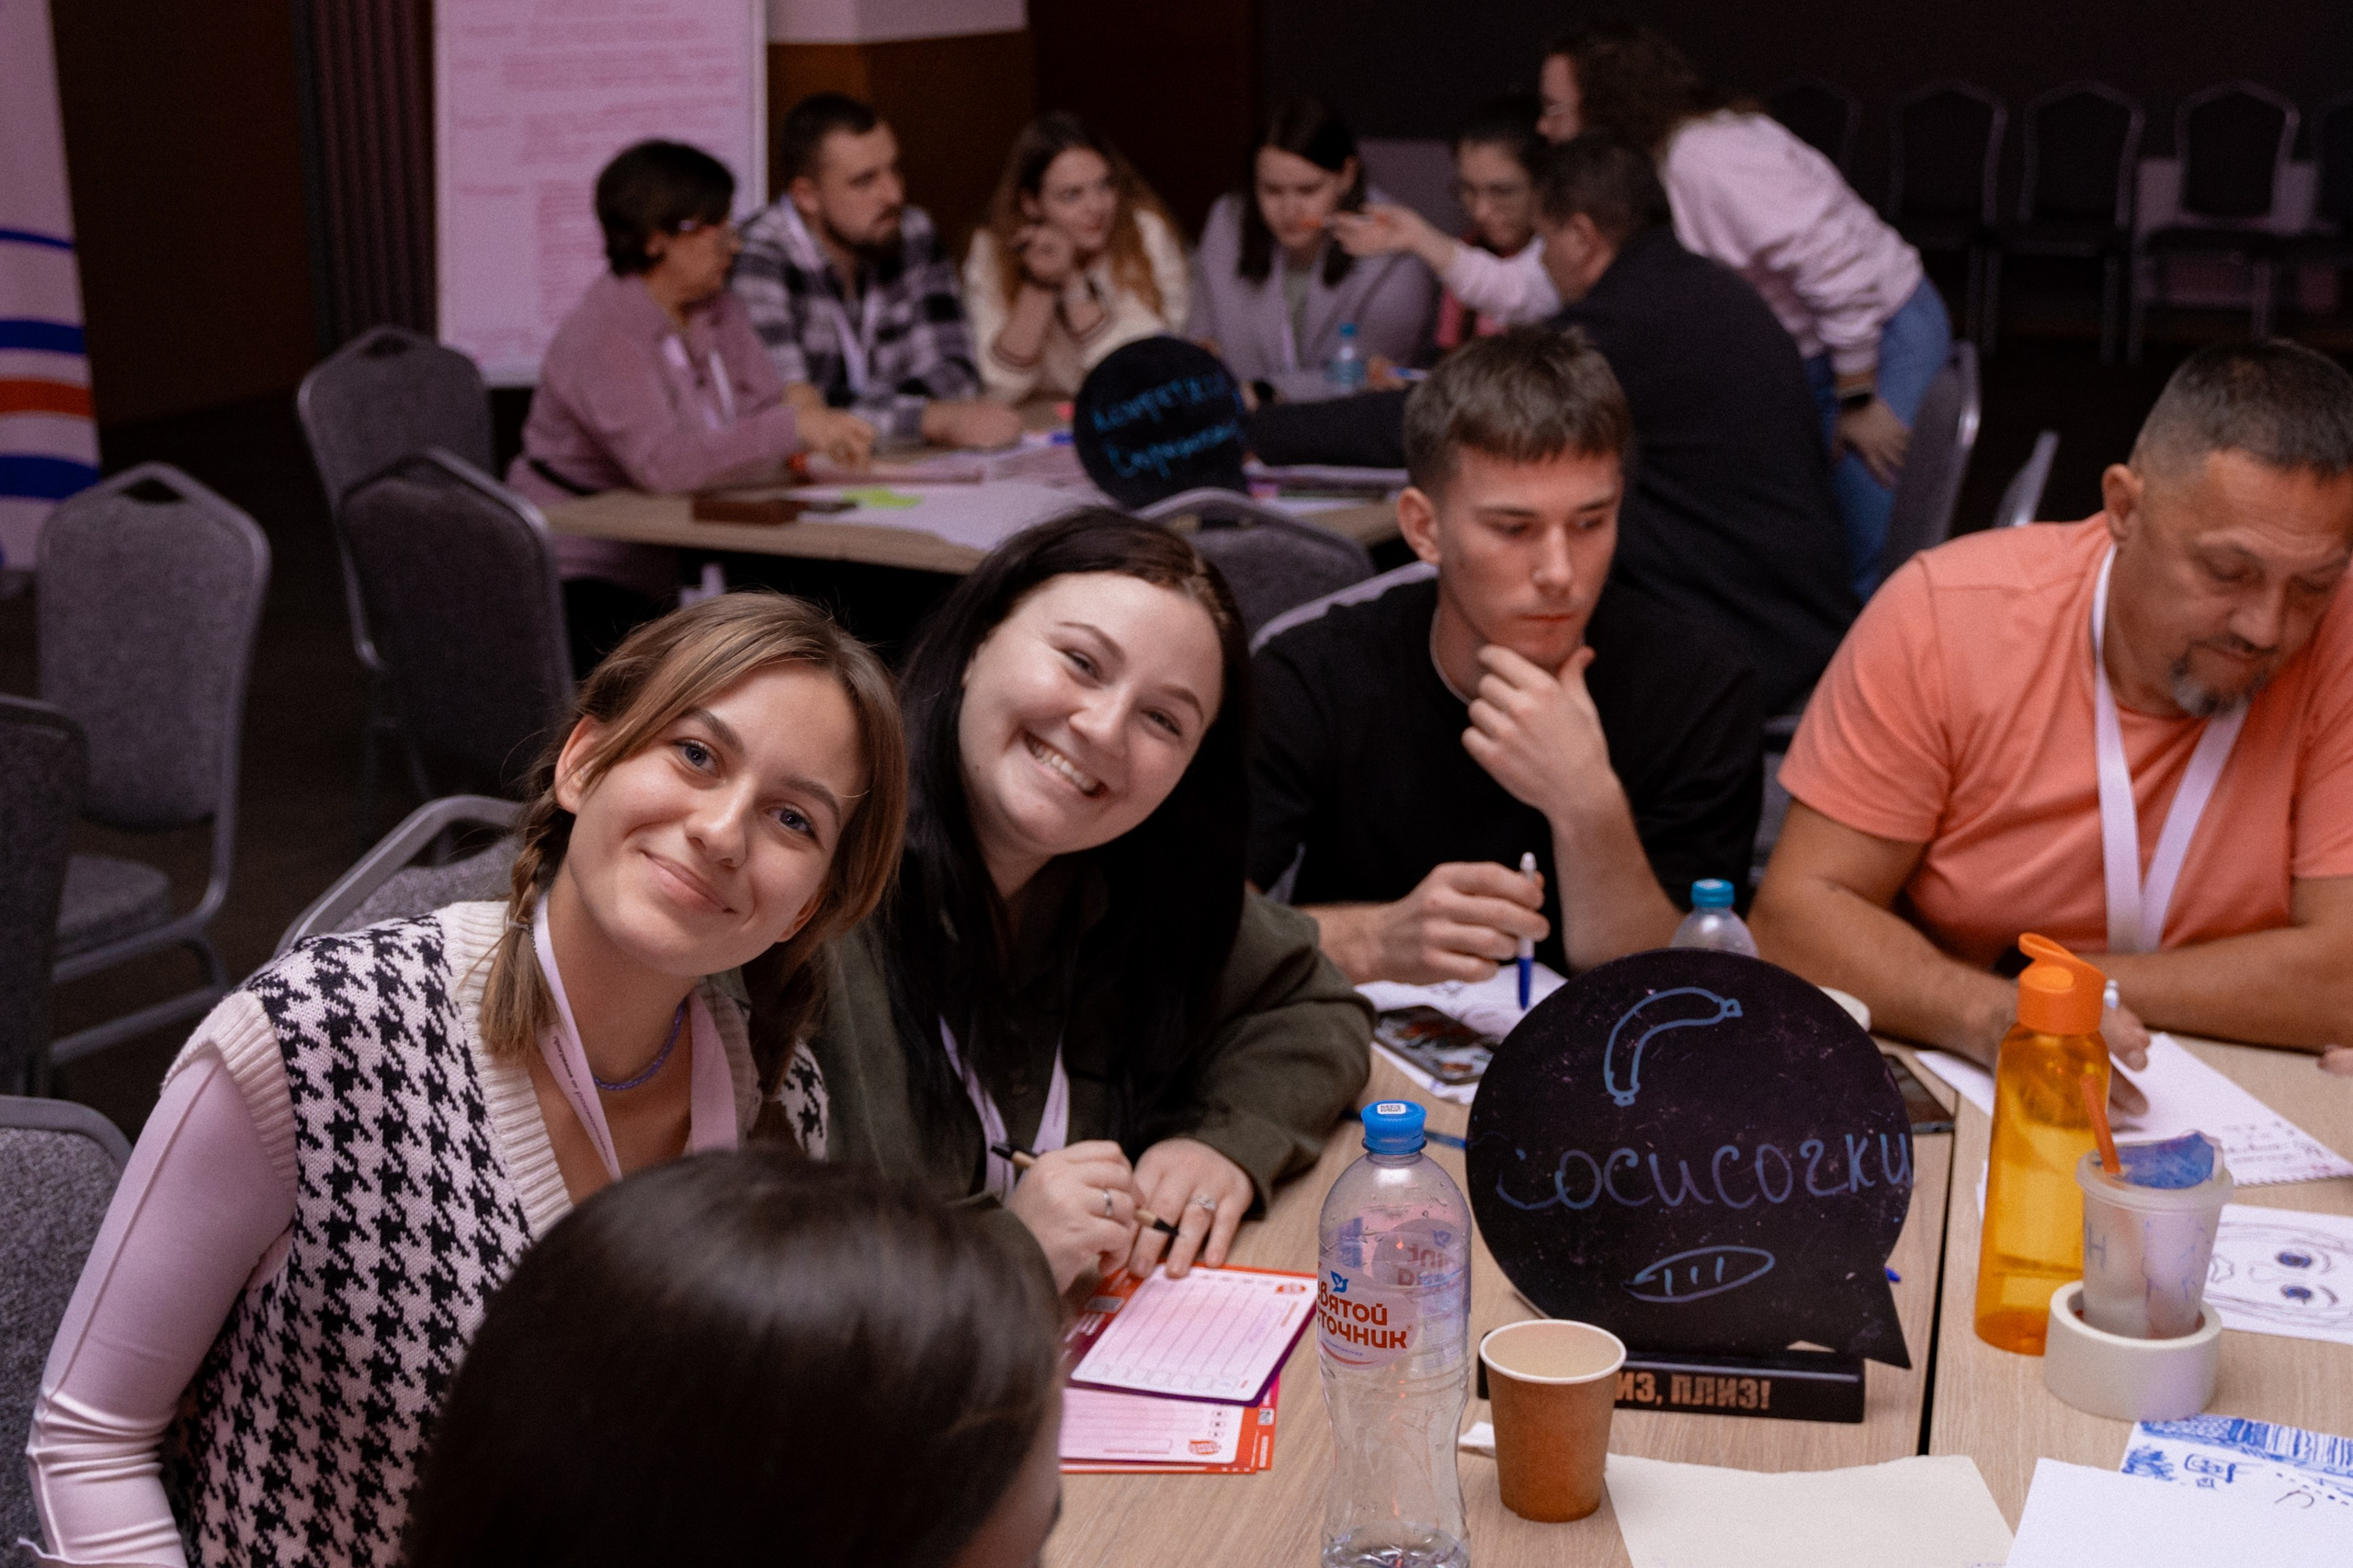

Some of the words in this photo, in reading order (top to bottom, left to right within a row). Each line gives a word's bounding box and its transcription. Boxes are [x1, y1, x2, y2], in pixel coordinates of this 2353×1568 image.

[1318, 1280, 1388, 1326] ВЯТОЙ
[1318, 1307, 1407, 1349] ТОЧНИК
[1615, 1370, 1664, 1406] ИЗ,
[1670, 1373, 1771, 1411] ПЛИЗ!
